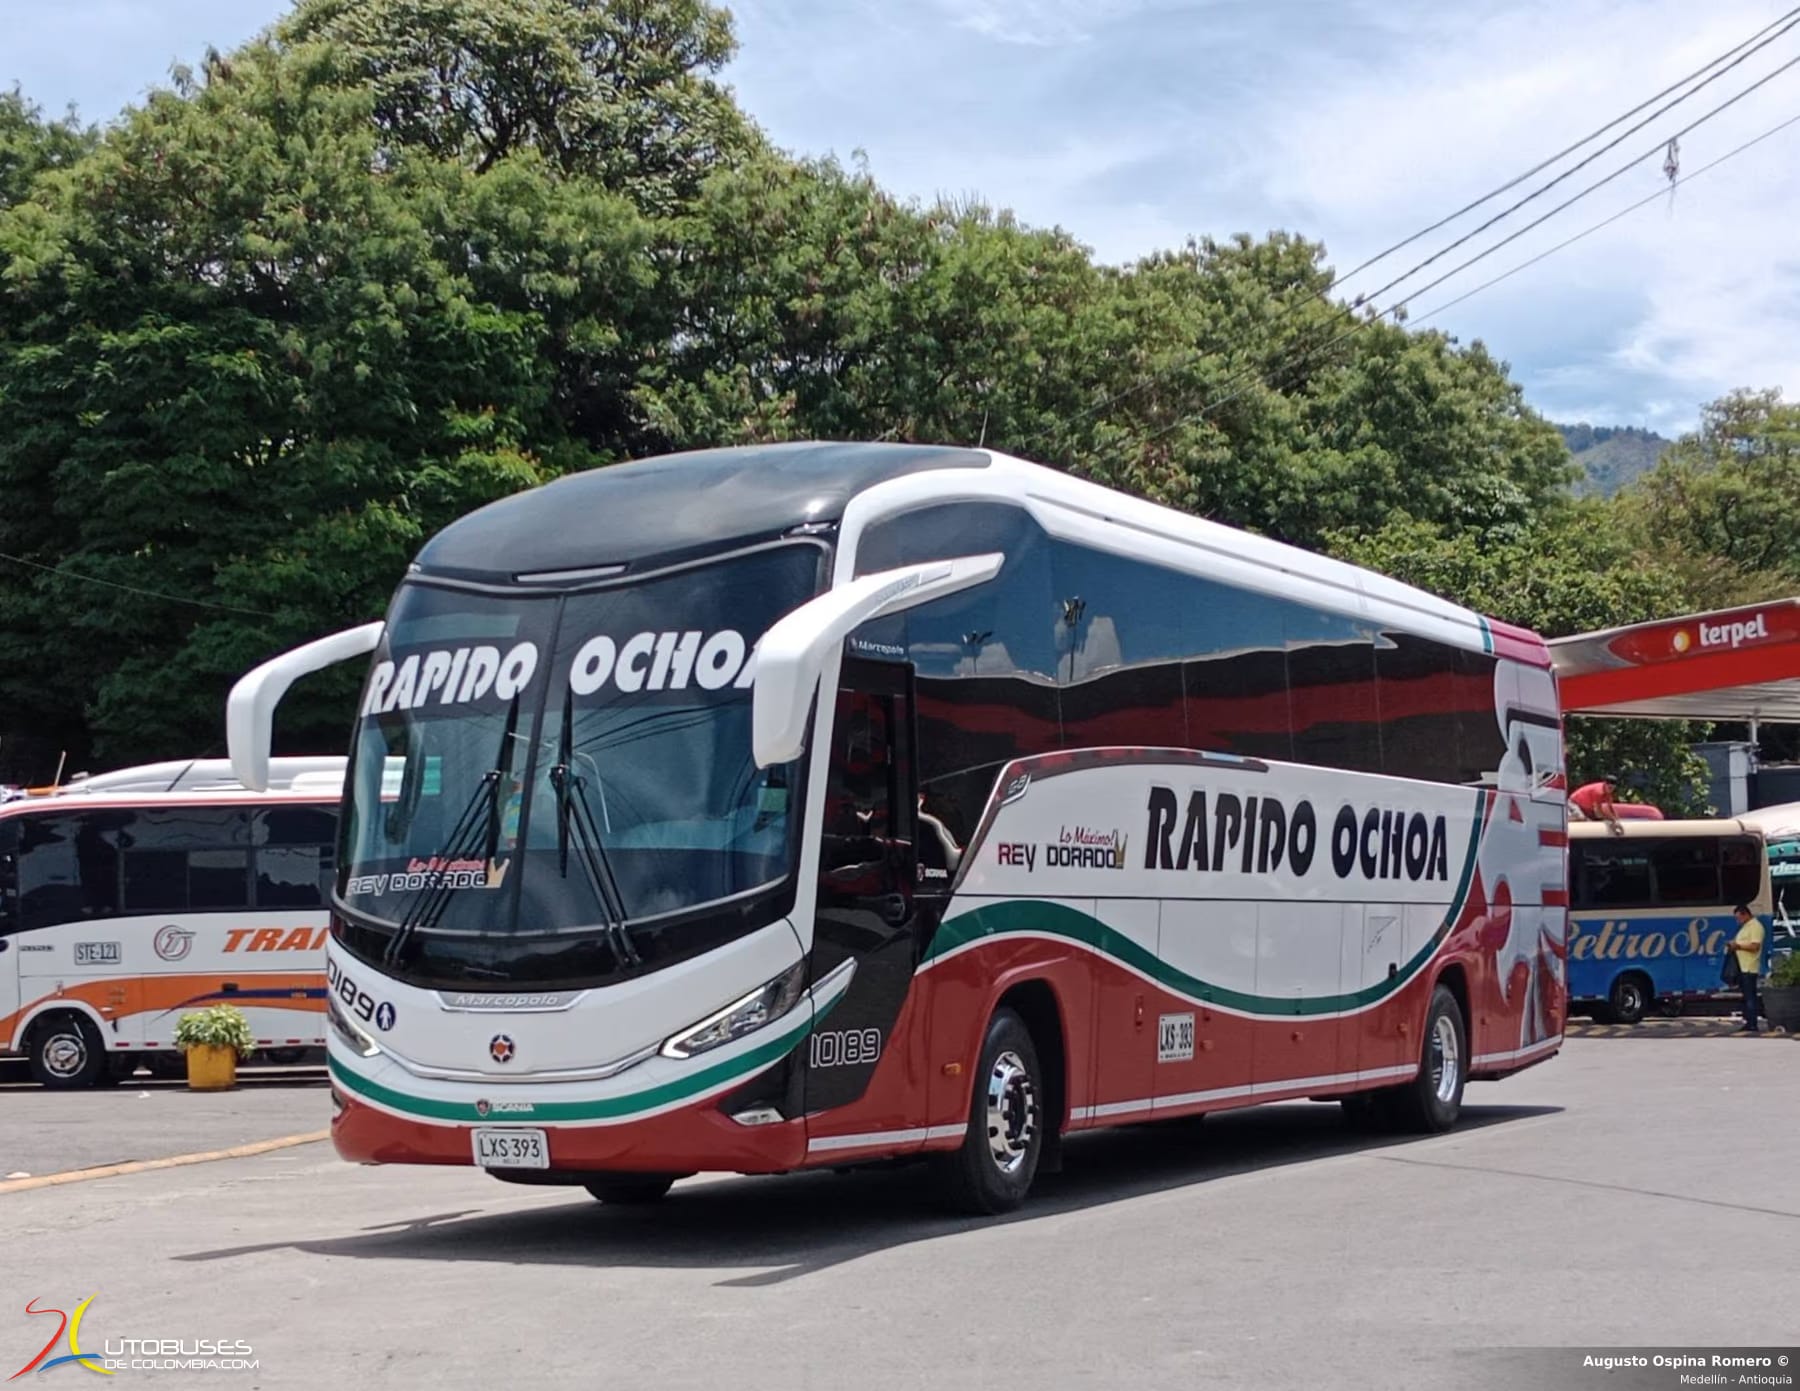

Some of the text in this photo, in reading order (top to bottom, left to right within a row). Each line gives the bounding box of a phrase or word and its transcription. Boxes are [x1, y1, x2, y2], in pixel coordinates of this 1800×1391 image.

[1700, 614, 1768, 648] terpel
[362, 630, 757, 717] RAPIDO OCHO
[1144, 786, 1448, 881] RAPIDO OCHOA
[1046, 844, 1117, 869] DORADO
[456, 995, 558, 1006] Marcopolo
[810, 1028, 880, 1068] 10189
